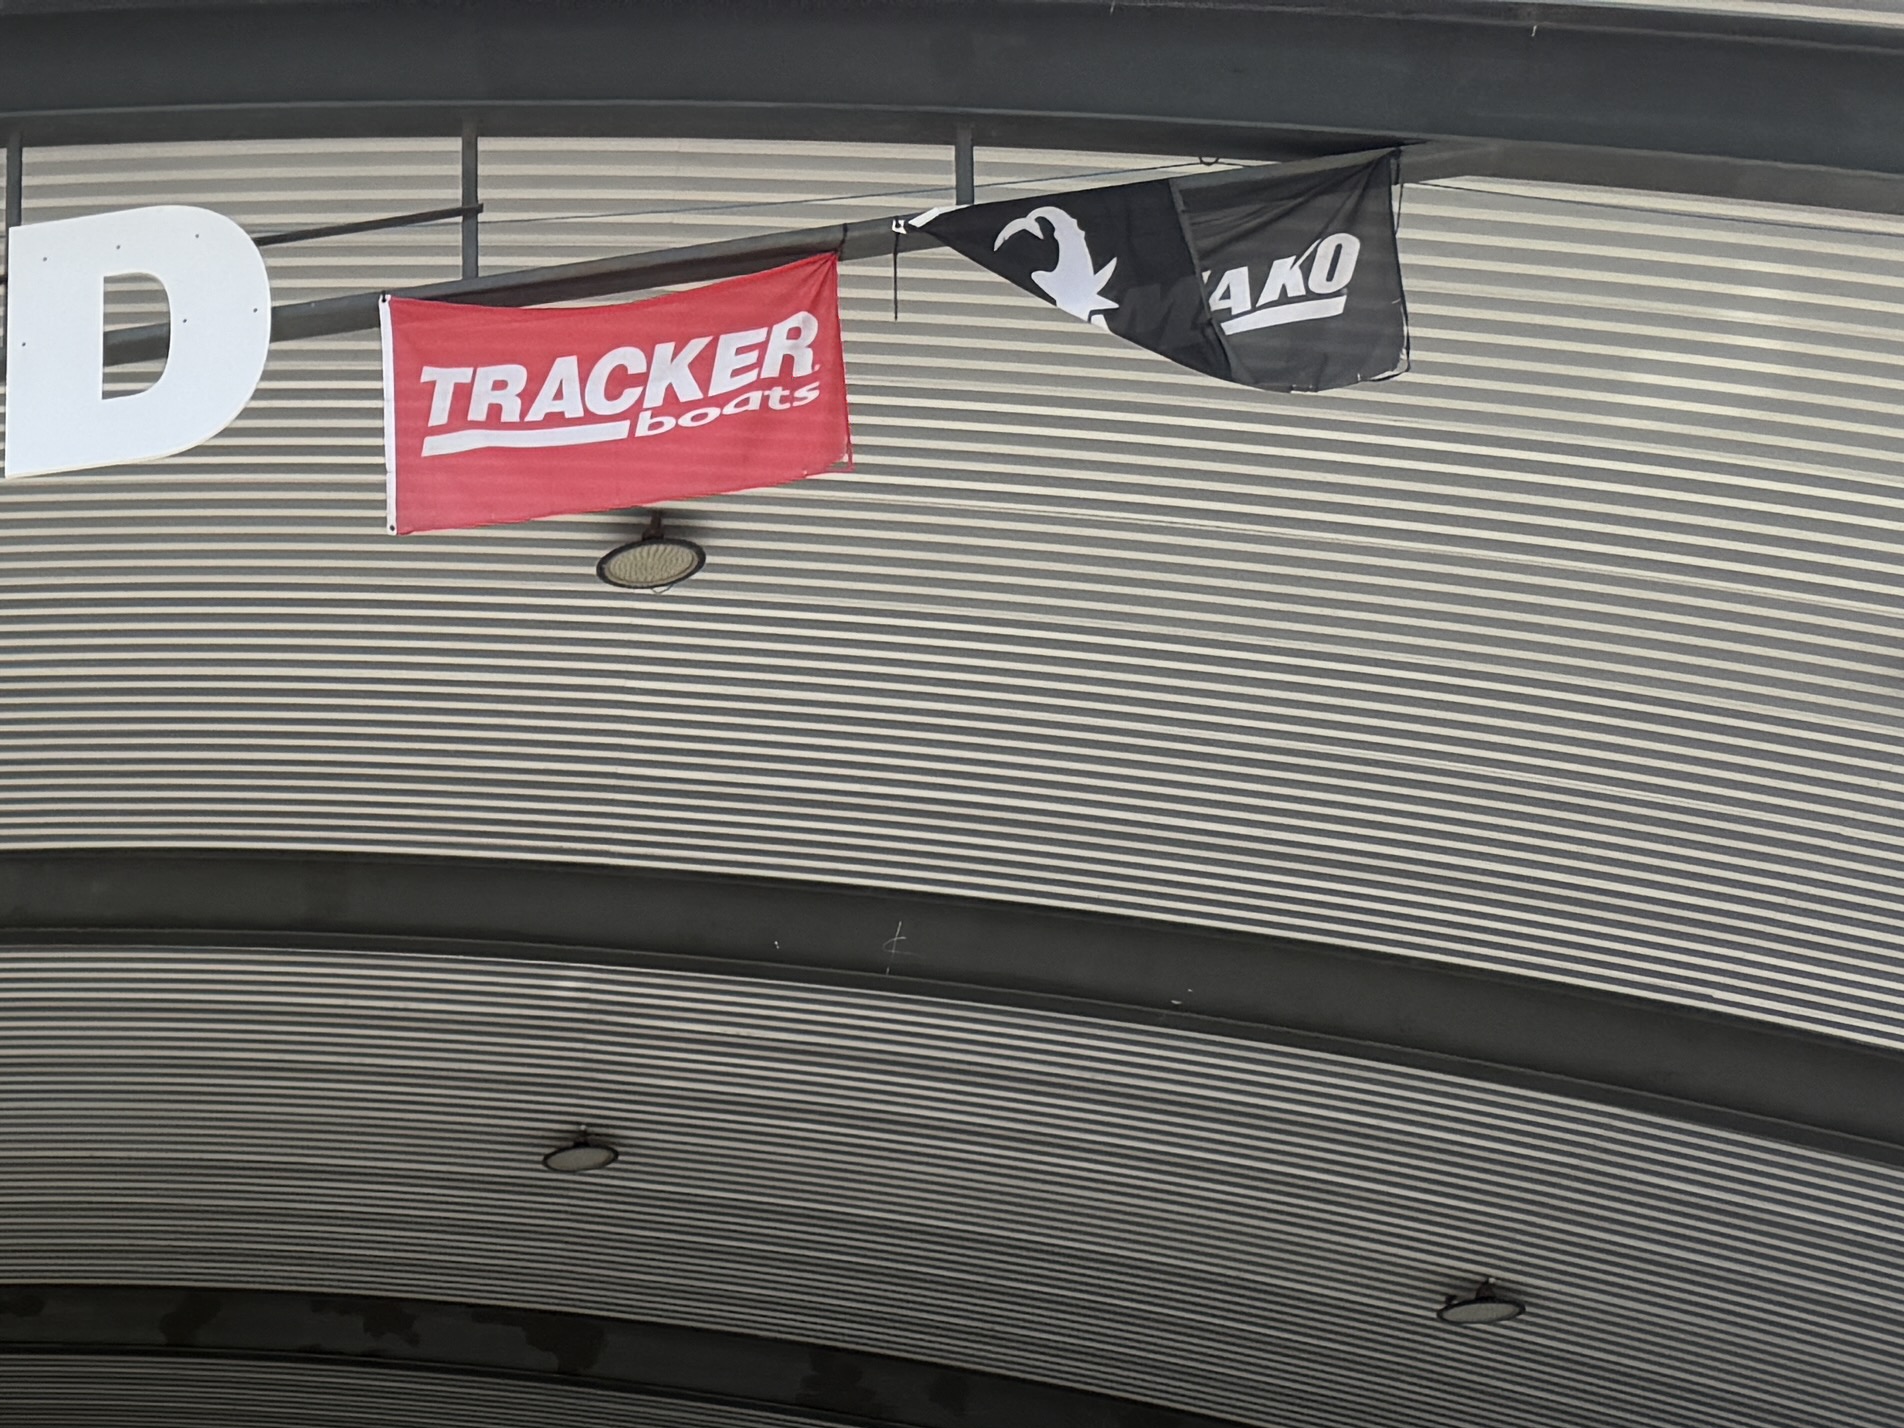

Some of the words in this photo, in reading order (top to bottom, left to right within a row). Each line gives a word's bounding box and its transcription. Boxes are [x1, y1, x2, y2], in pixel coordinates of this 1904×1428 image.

[1202, 233, 1361, 315] AKO
[419, 310, 820, 427] TRACKER
[633, 380, 820, 438] boats
